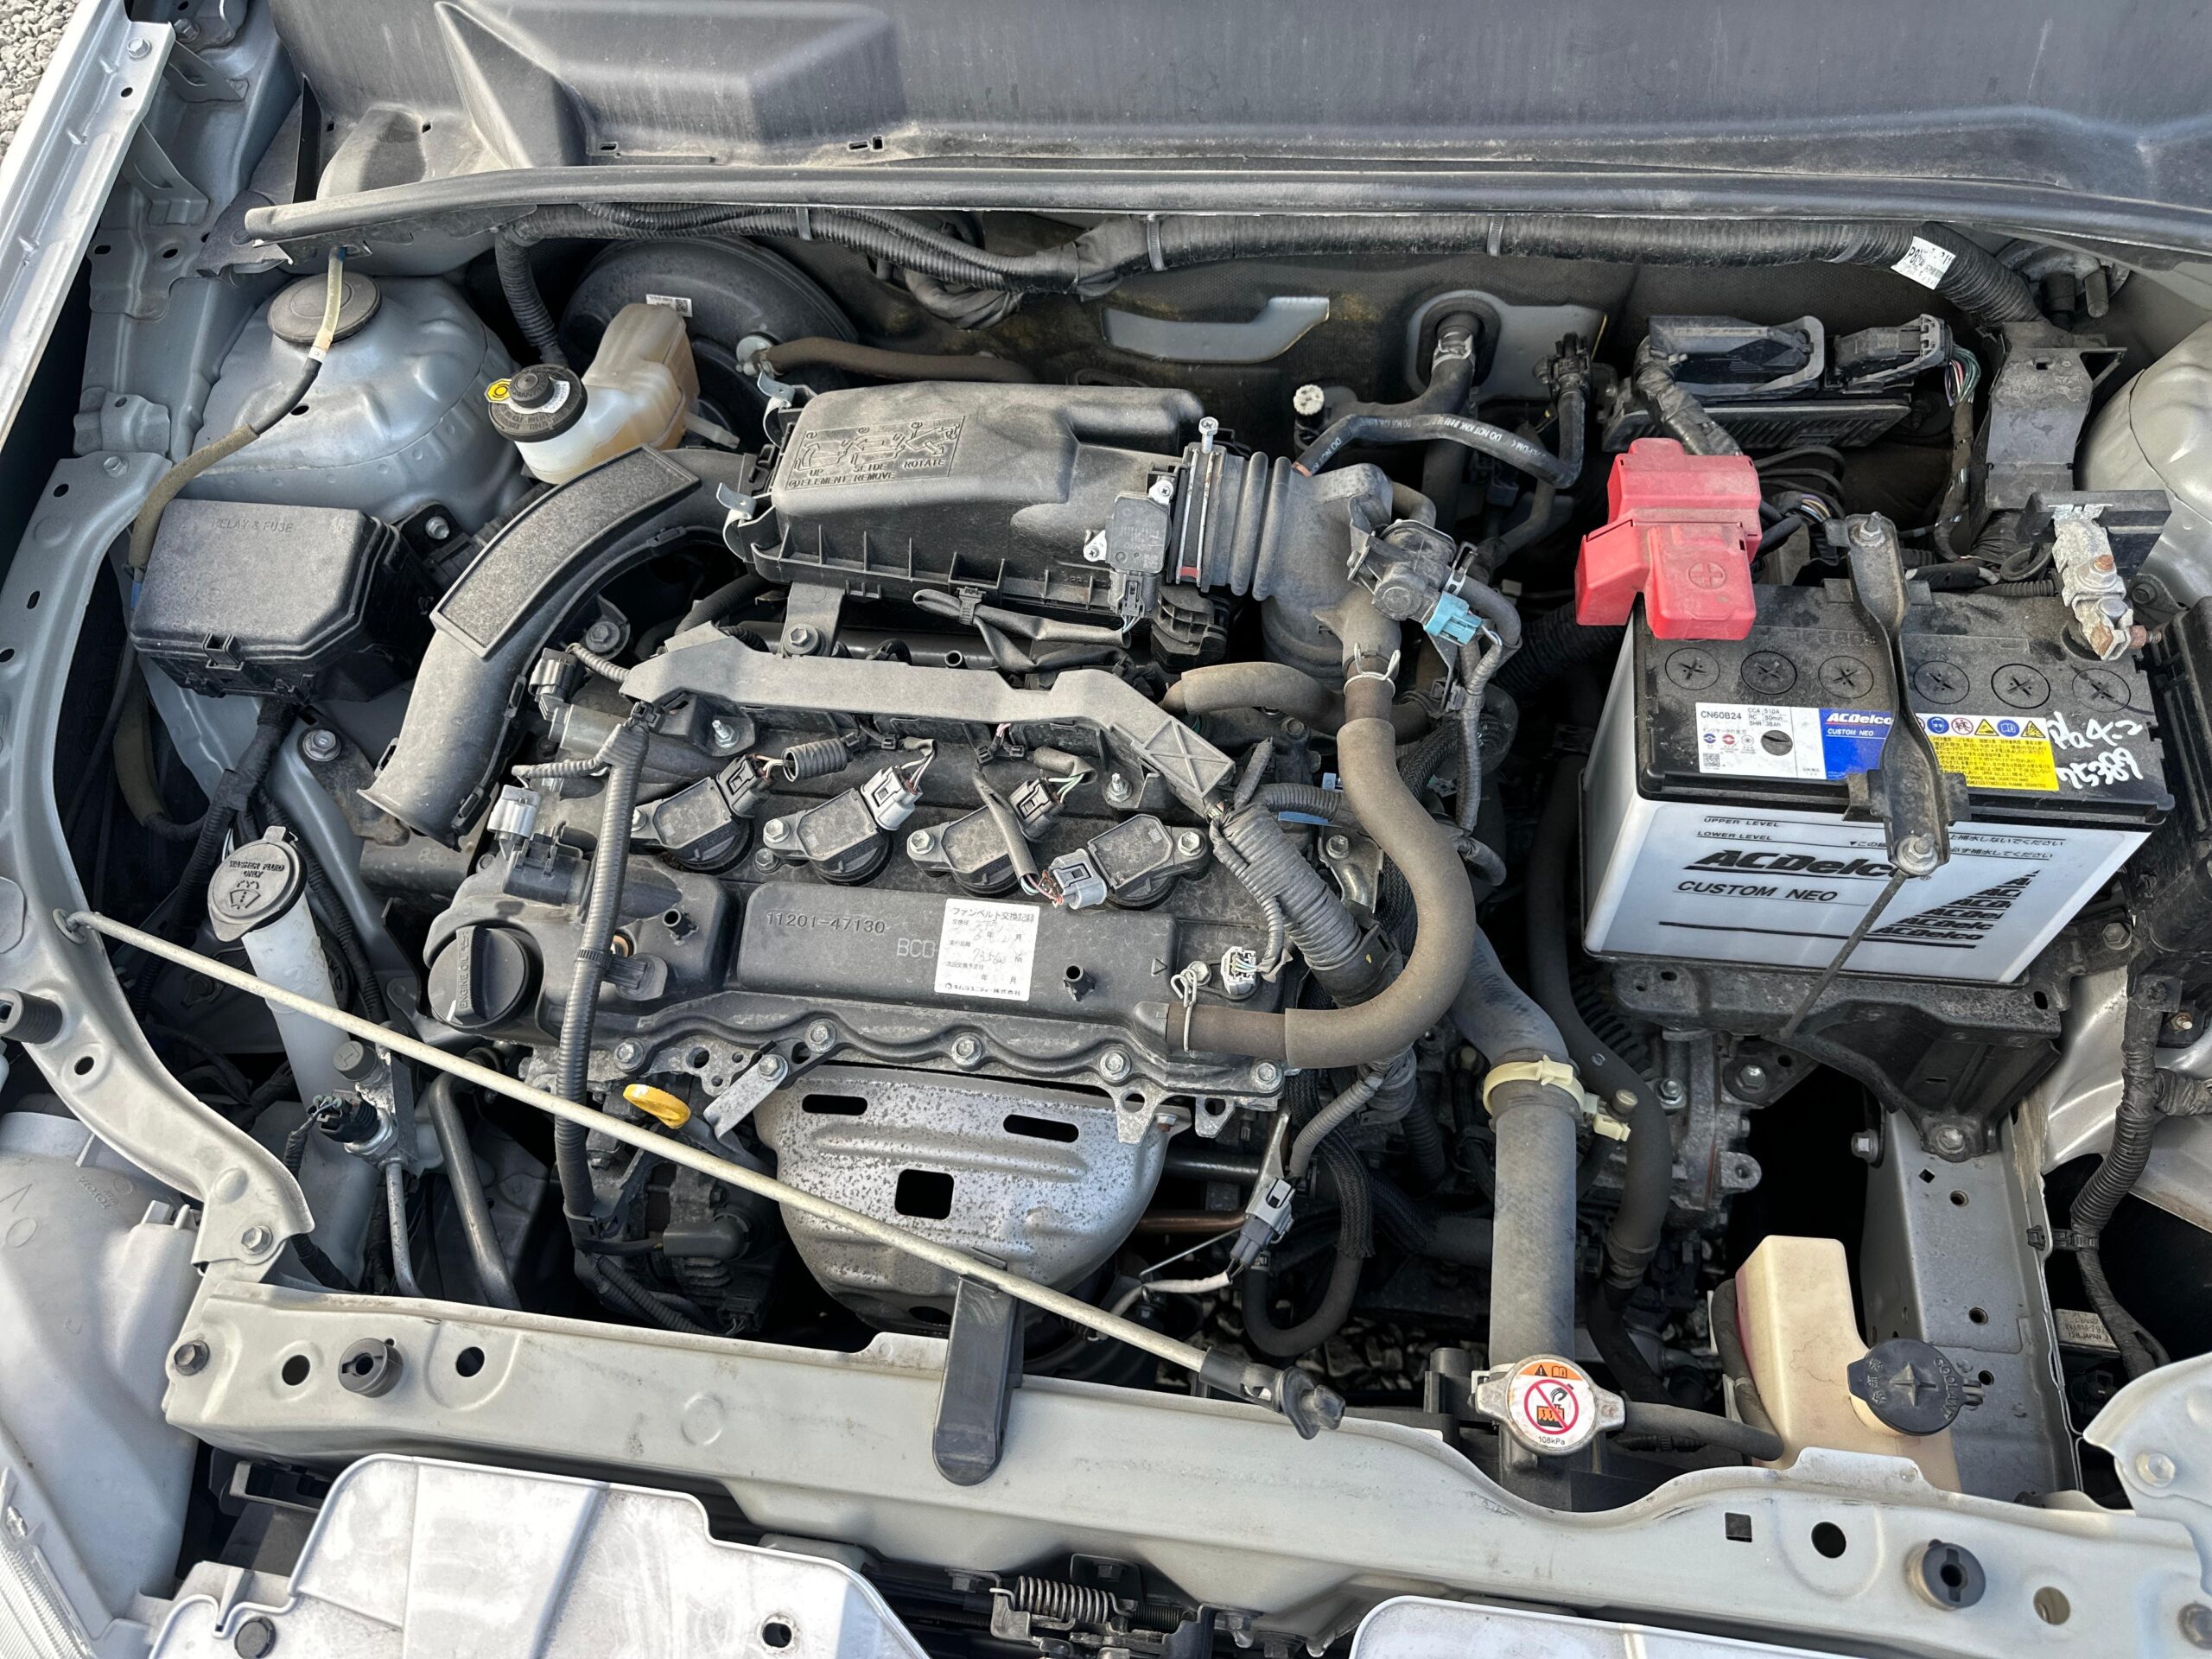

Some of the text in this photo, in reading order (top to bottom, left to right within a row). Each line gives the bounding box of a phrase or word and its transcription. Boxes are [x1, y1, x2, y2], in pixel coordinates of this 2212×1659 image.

[903, 458, 946, 469] ROTATE
[809, 468, 824, 477] UP
[213, 518, 248, 531] RELAY
[263, 521, 294, 533] FUSE
[1700, 710, 1742, 720] CN60B24
[1825, 712, 1892, 725] ACDelco
[1677, 880, 1838, 901] CUSTOM NEO
[952, 907, 1034, 923] ファンベルト交換記録
[766, 911, 887, 935] 11201-47130
[986, 931, 995, 939] 年
[1872, 925, 1985, 940] ACDelco
[1009, 976, 1017, 984] 月
[459, 972, 470, 1010] ENGINE
[1934, 1357, 1959, 1420] COOLANT
[1538, 1435, 1566, 1446] 108kPa
